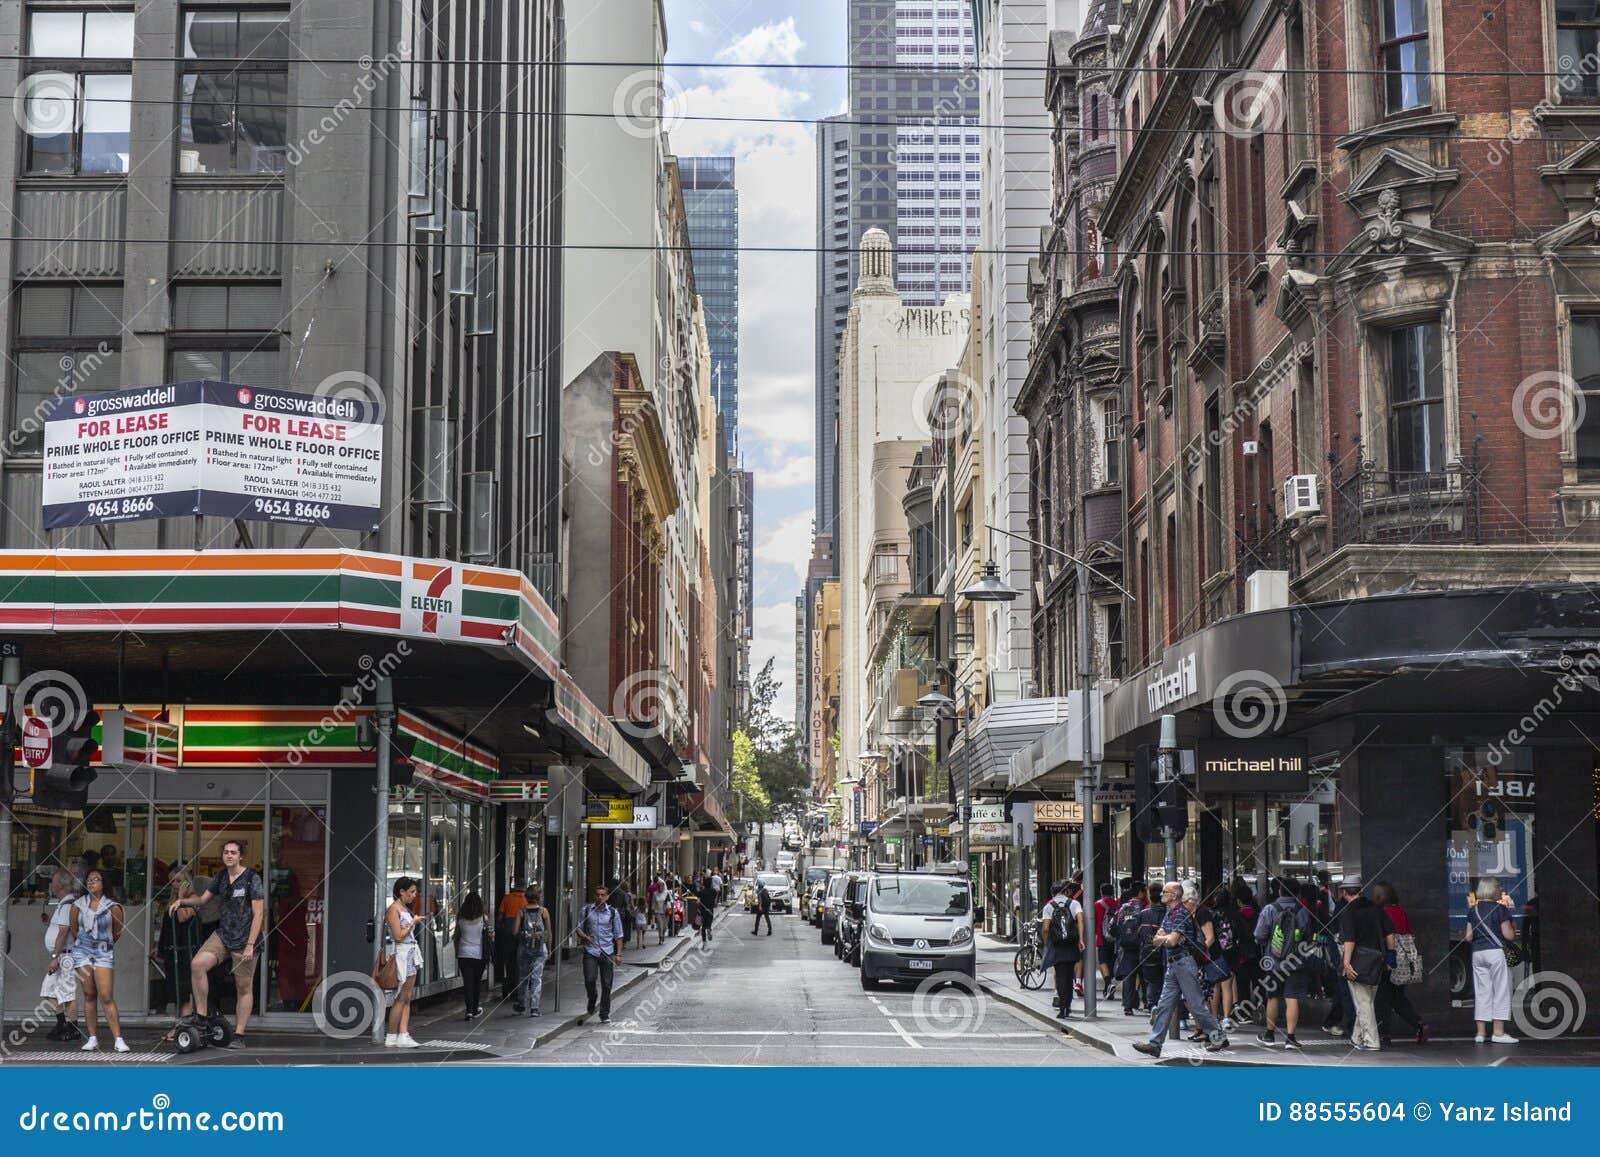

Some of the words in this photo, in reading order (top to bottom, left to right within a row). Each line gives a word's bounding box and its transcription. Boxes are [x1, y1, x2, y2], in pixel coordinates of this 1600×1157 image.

[88, 386, 175, 416] grosswaddell
[254, 393, 354, 418] grosswaddell
[78, 420, 110, 439] FOR
[116, 412, 168, 434] LEASE
[242, 414, 280, 434] FOR
[288, 420, 346, 441] LEASE
[47, 444, 80, 457] PRIME
[83, 440, 120, 454] WHOLE
[124, 434, 158, 449] FLOOR
[162, 430, 200, 444] OFFICE
[206, 430, 244, 446] PRIME
[248, 435, 292, 451] WHOLE
[296, 442, 335, 456] FLOOR
[338, 446, 380, 461] OFFICE
[129, 454, 144, 463] Fully
[145, 452, 156, 460] self
[157, 449, 188, 459] contained
[212, 448, 238, 458] Bathed
[248, 452, 275, 463] natural
[276, 455, 293, 466] light
[212, 458, 231, 466] Floor
[52, 462, 74, 470] Bathed
[83, 458, 105, 467] natural
[106, 457, 120, 466] light
[128, 462, 157, 472] Available
[158, 458, 198, 468] immediately
[302, 458, 318, 469] Fully
[320, 461, 332, 469] self
[334, 463, 368, 472] contained
[52, 472, 68, 480] Floor
[244, 475, 270, 485] RAOUL
[272, 478, 298, 488] SALTER
[302, 468, 334, 478] Available
[335, 472, 378, 484] immediately
[79, 480, 101, 489] RAOUL
[102, 478, 126, 487] SALTER
[78, 490, 103, 499] STEVEN
[104, 488, 126, 496] HAIGH
[244, 485, 272, 495] STEVEN
[274, 488, 298, 497] HAIGH
[88, 500, 119, 517] 9654
[122, 496, 154, 514] 8666
[254, 498, 291, 516] 9654
[294, 502, 330, 519] 8666
[422, 566, 452, 633] 7
[3, 644, 16, 655] St
[814, 632, 822, 701] VICTORIA
[28, 726, 40, 736] NO
[813, 711, 821, 758] HOTEL
[25, 749, 46, 760] ENTRY
[1206, 758, 1274, 772] michael
[1280, 758, 1302, 771] hill
[609, 803, 633, 812] AURANT
[1036, 804, 1080, 818] KESHE
